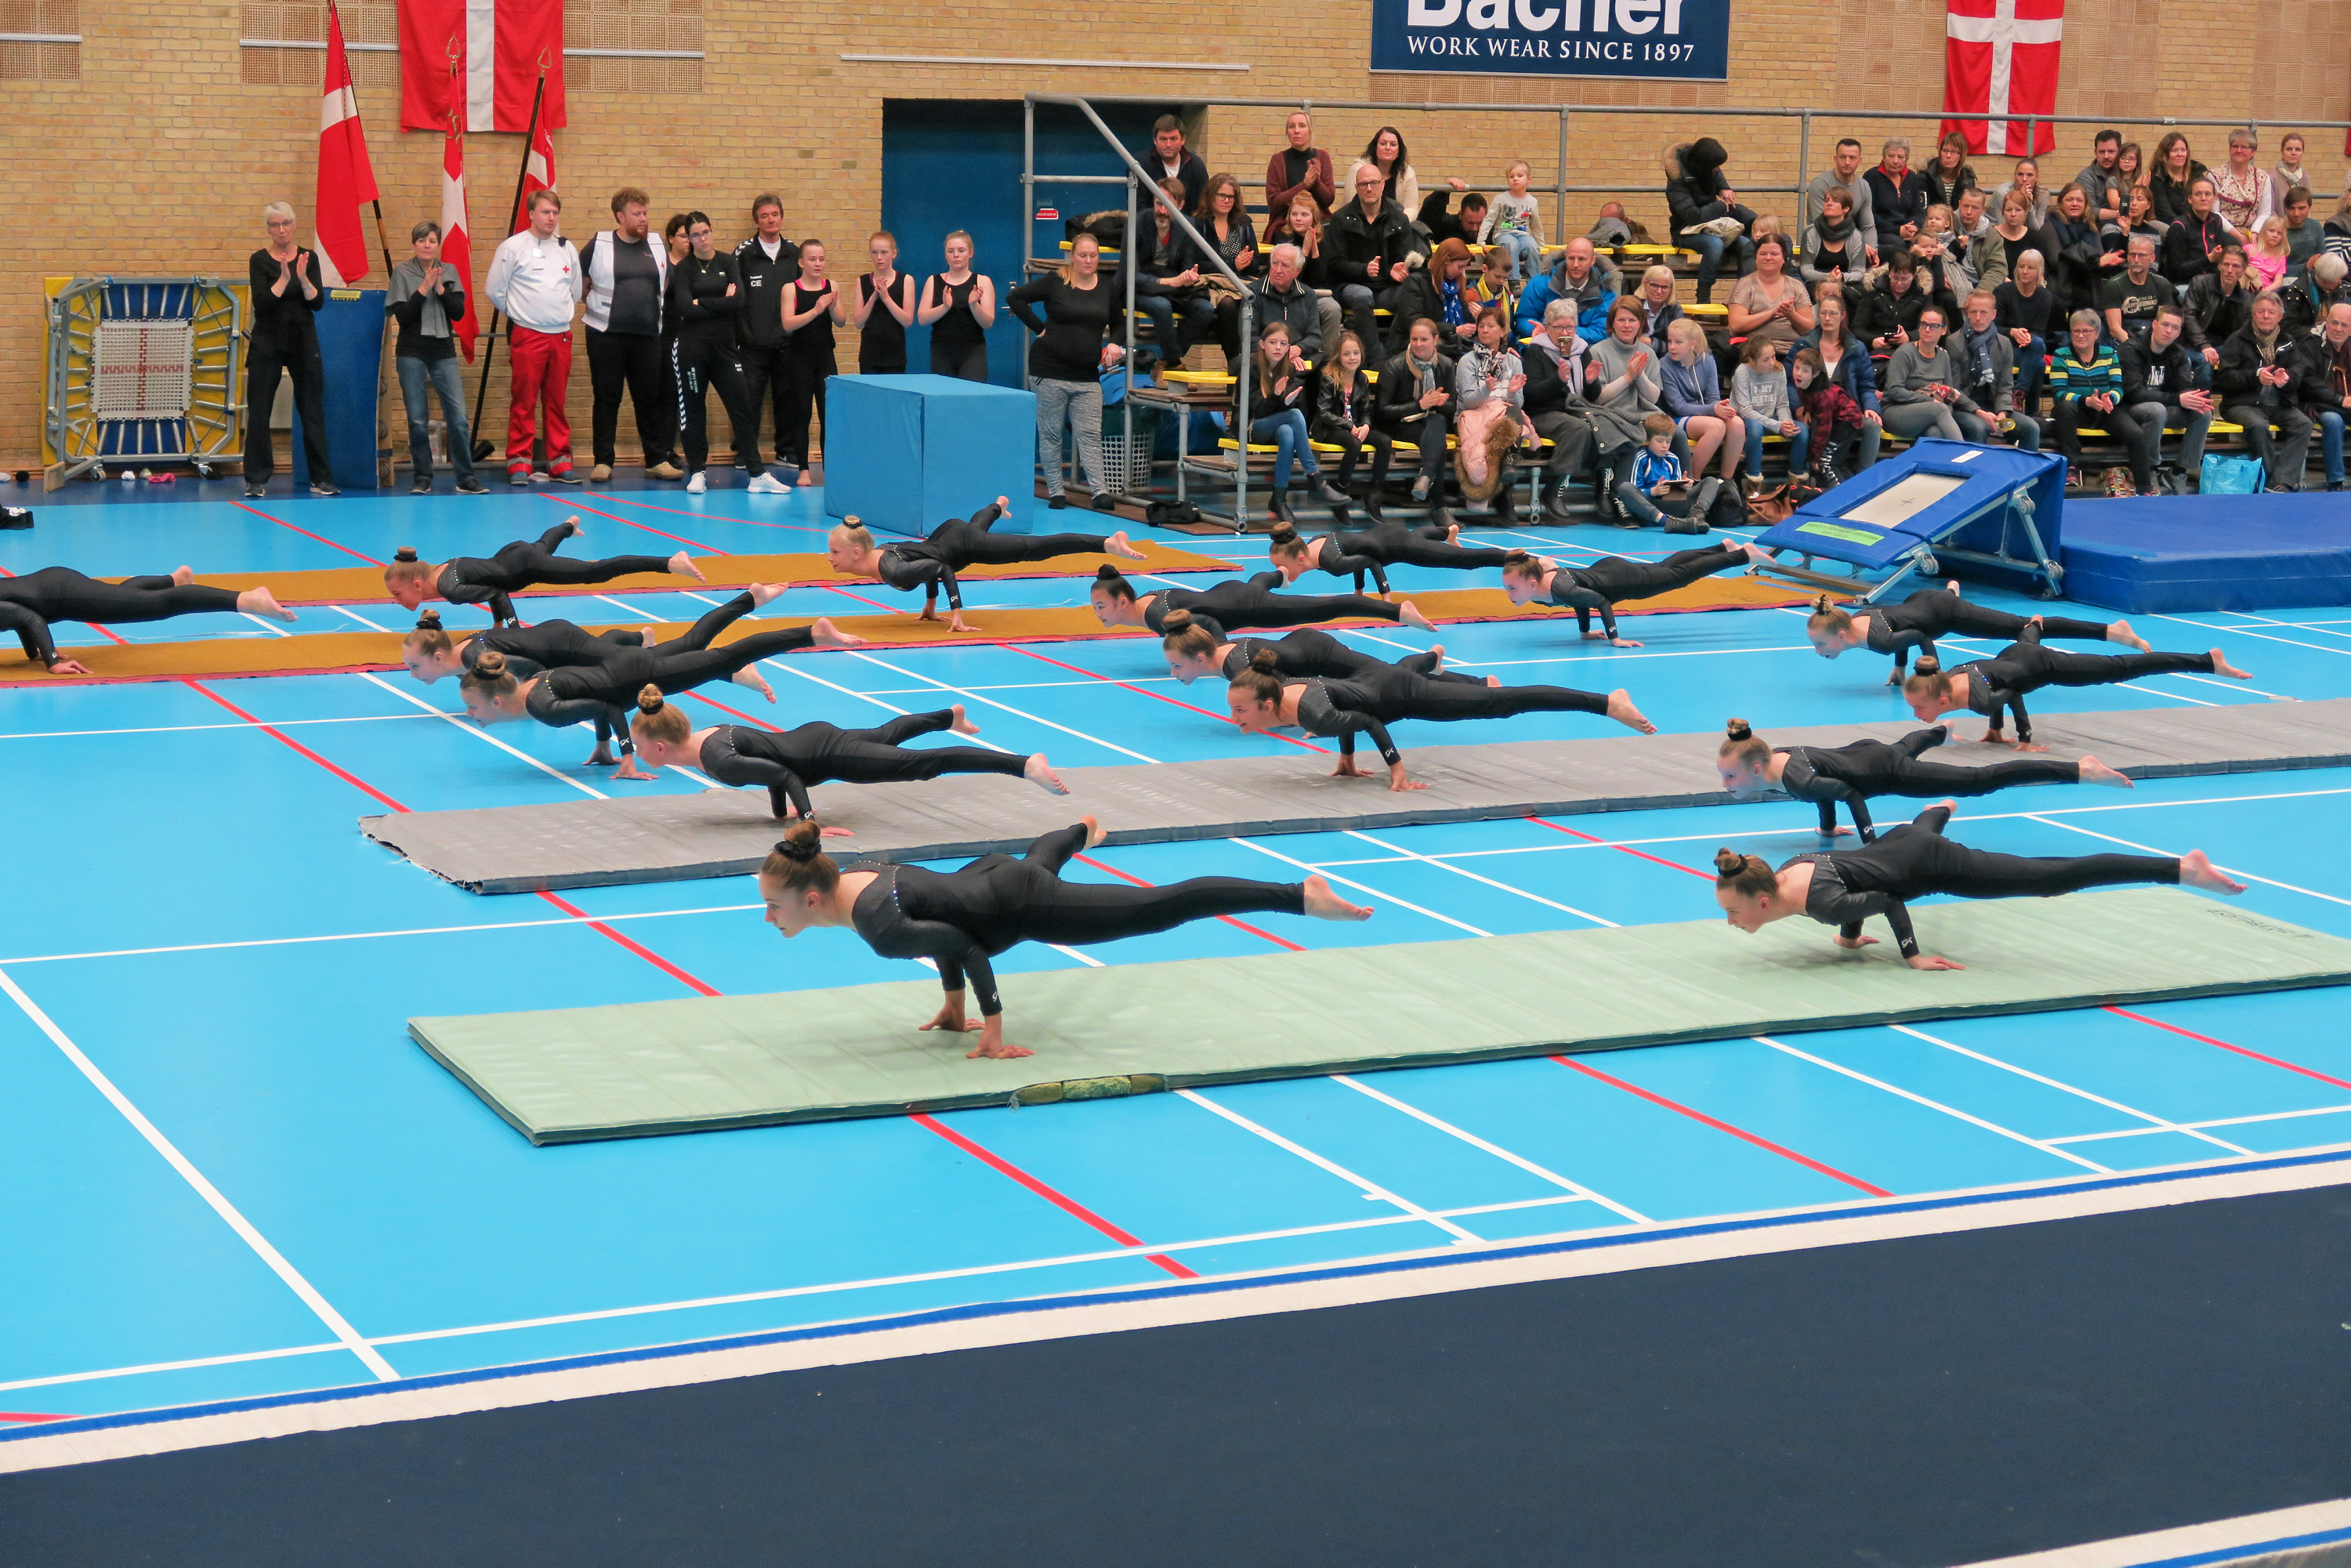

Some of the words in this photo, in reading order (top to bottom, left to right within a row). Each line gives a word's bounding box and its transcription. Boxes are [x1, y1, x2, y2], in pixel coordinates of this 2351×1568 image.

[1407, 35, 1480, 56] WORK
[1487, 38, 1567, 58] WEAR
[1559, 40, 1633, 60] SINCE
[1644, 43, 1694, 62] 1897
[1762, 384, 1773, 393] MY
[1751, 394, 1775, 404] BESTIE
